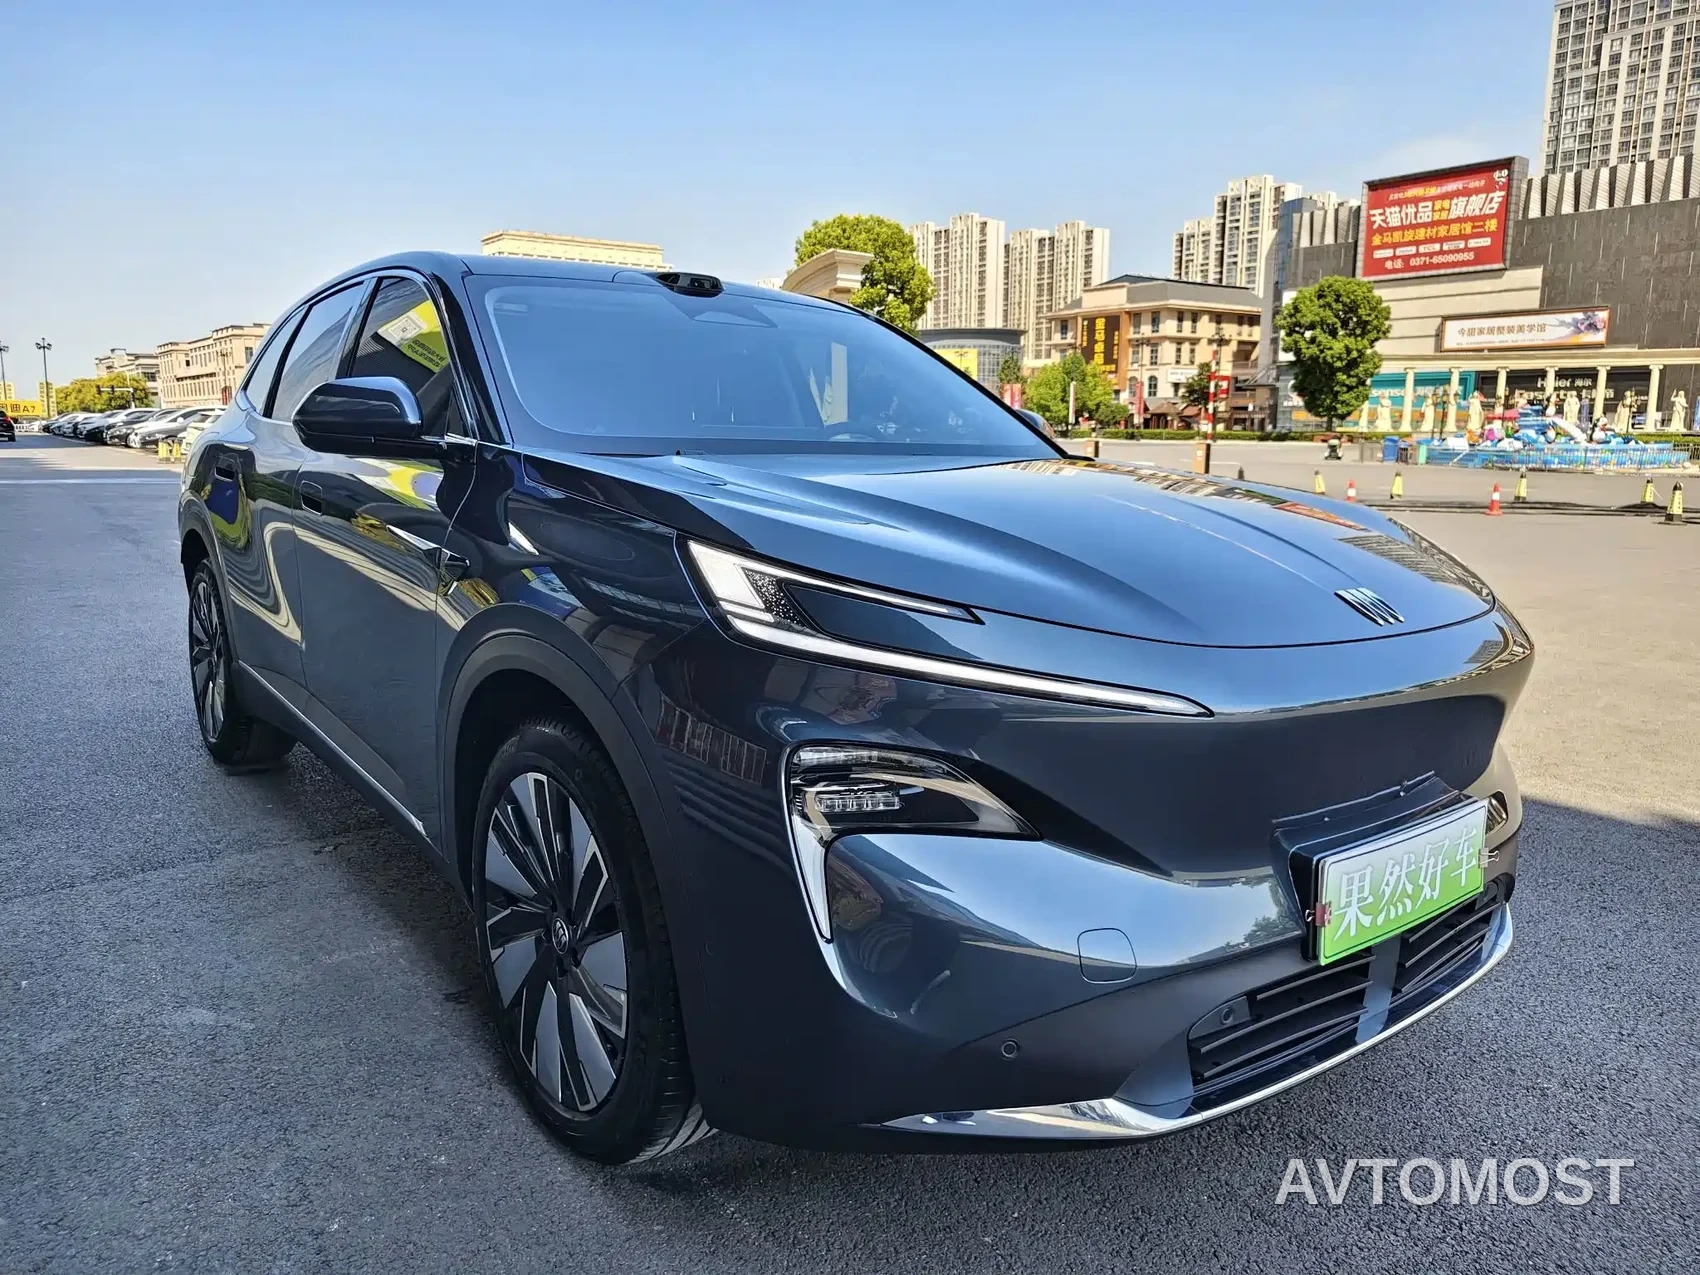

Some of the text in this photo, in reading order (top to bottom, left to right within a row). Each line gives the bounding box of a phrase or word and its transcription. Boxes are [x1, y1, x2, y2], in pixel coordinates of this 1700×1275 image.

[1369, 201, 1433, 229] 天猫优品
[1448, 190, 1505, 219] 旗舰店
[1371, 219, 1498, 246] 金马凯旋建材家居馆二楼
[1537, 377, 1571, 388] Hier
[1333, 827, 1478, 941] 果然好车
